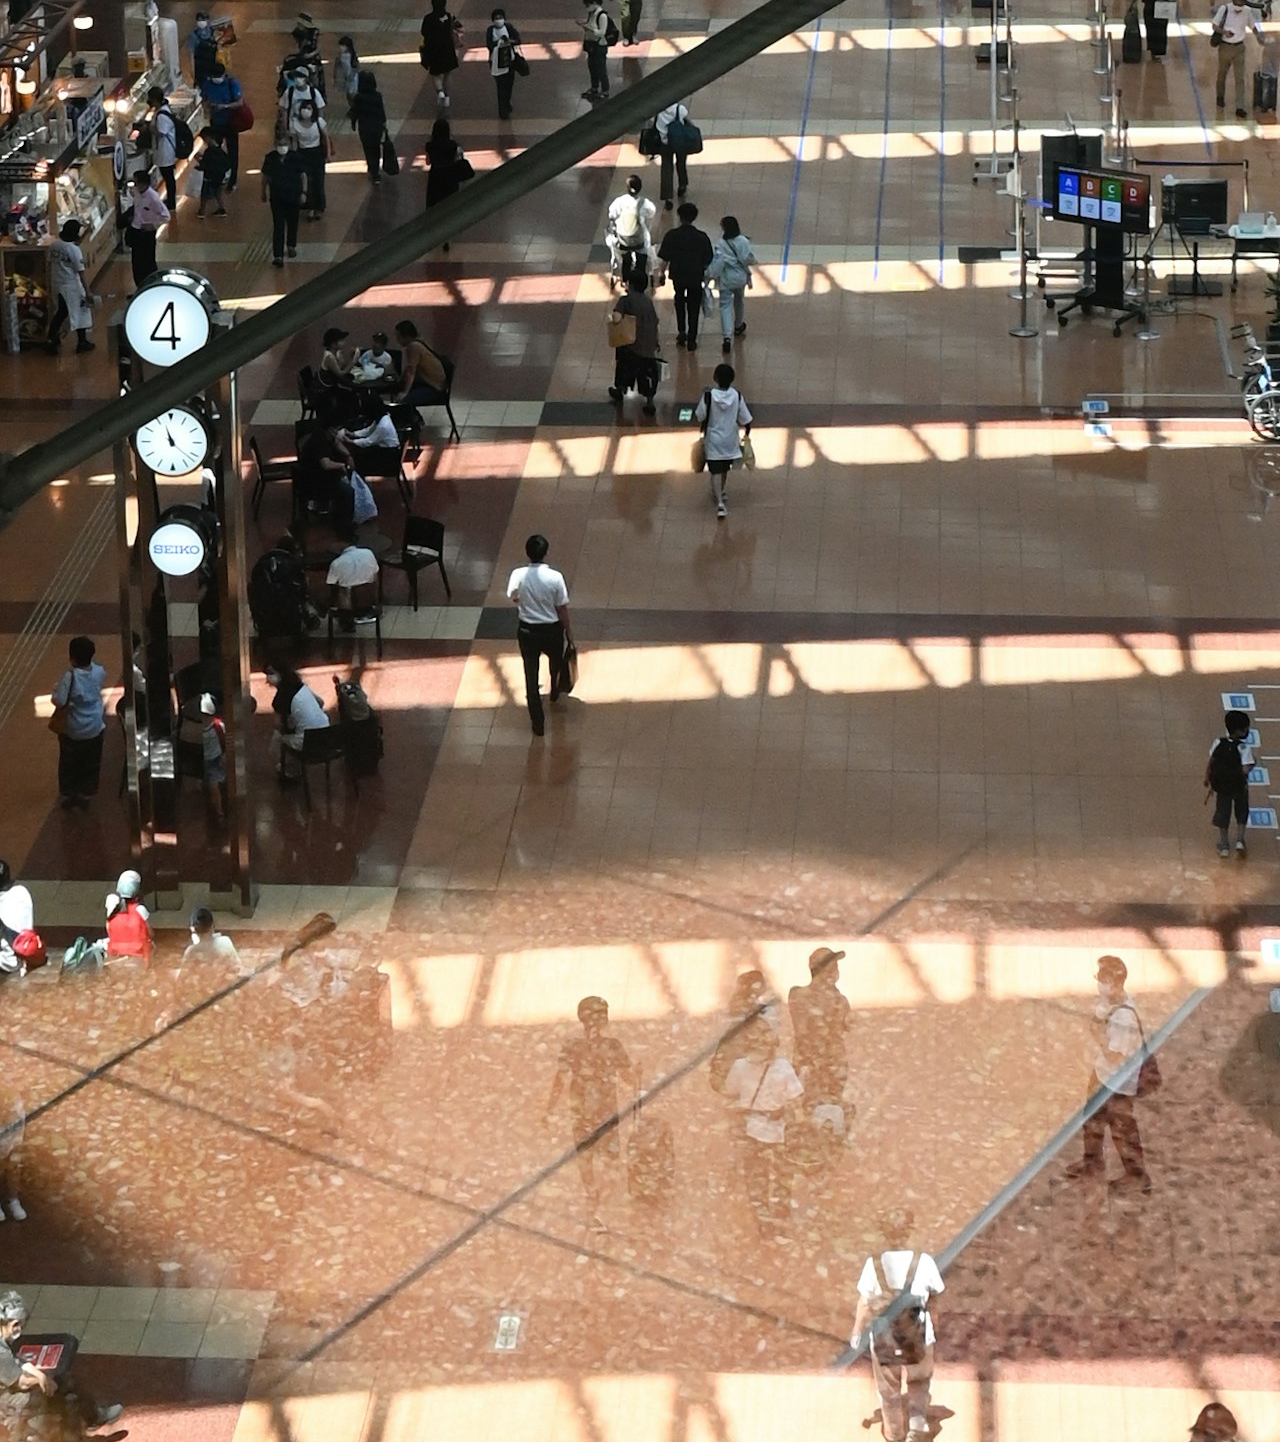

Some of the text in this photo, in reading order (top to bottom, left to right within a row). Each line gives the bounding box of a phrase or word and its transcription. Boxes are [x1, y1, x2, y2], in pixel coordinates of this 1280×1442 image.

[1065, 177, 1073, 187] A
[1086, 181, 1094, 191] B
[1108, 184, 1115, 194] C
[1129, 188, 1137, 197] D
[150, 301, 181, 350] 4
[153, 544, 200, 556] SEIKO
